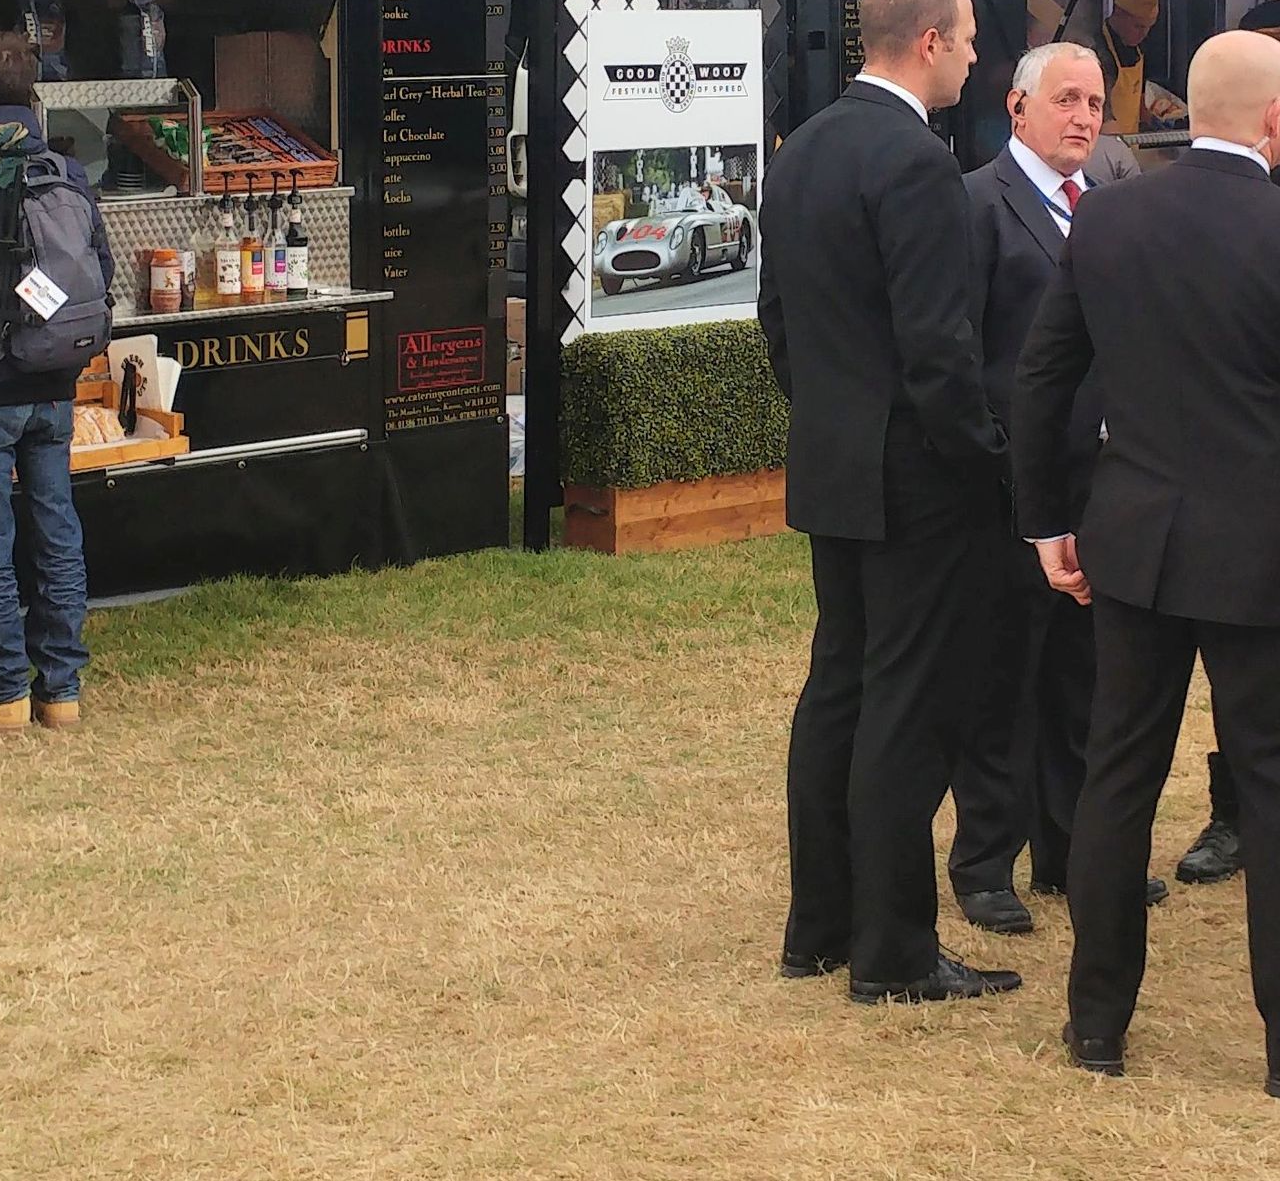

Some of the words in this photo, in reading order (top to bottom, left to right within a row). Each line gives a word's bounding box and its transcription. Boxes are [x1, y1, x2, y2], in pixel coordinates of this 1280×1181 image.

[382, 7, 409, 19] ookie
[487, 6, 503, 15] 2.00
[616, 68, 655, 80] GOOD
[699, 66, 741, 78] WOOD
[383, 88, 397, 100] arl
[399, 86, 422, 103] Grey
[466, 84, 486, 98] Teas
[612, 85, 659, 95] FESTIVAL
[713, 85, 742, 93] SPEED
[383, 108, 406, 122] offee
[399, 127, 445, 142] Chocolate
[383, 151, 431, 167] appuccino
[383, 174, 402, 184] atte
[384, 247, 403, 258] uice
[174, 328, 309, 370] DRINKS
[402, 335, 482, 356] Allergens
